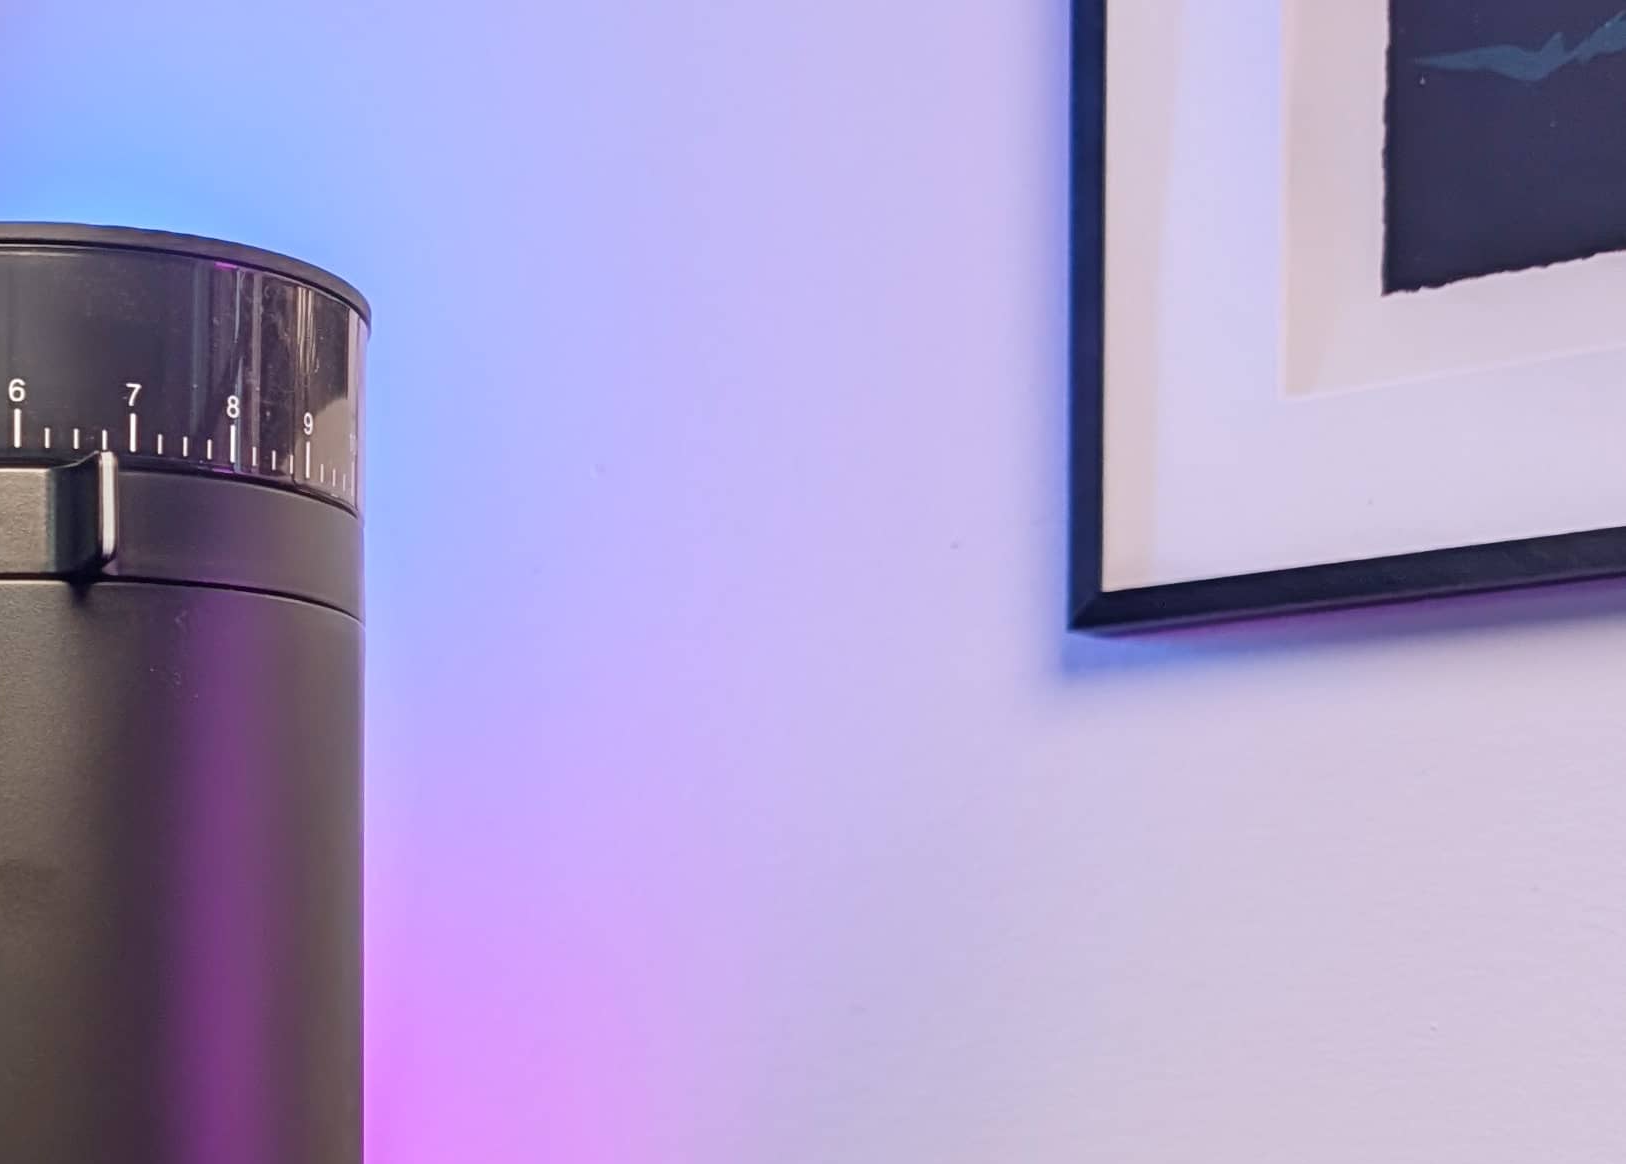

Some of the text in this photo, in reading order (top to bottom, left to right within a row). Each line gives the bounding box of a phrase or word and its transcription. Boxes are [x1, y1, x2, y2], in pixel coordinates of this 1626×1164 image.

[9, 378, 26, 403] 6
[127, 382, 142, 407] 7
[226, 394, 241, 419] 8
[303, 411, 314, 435] 9
